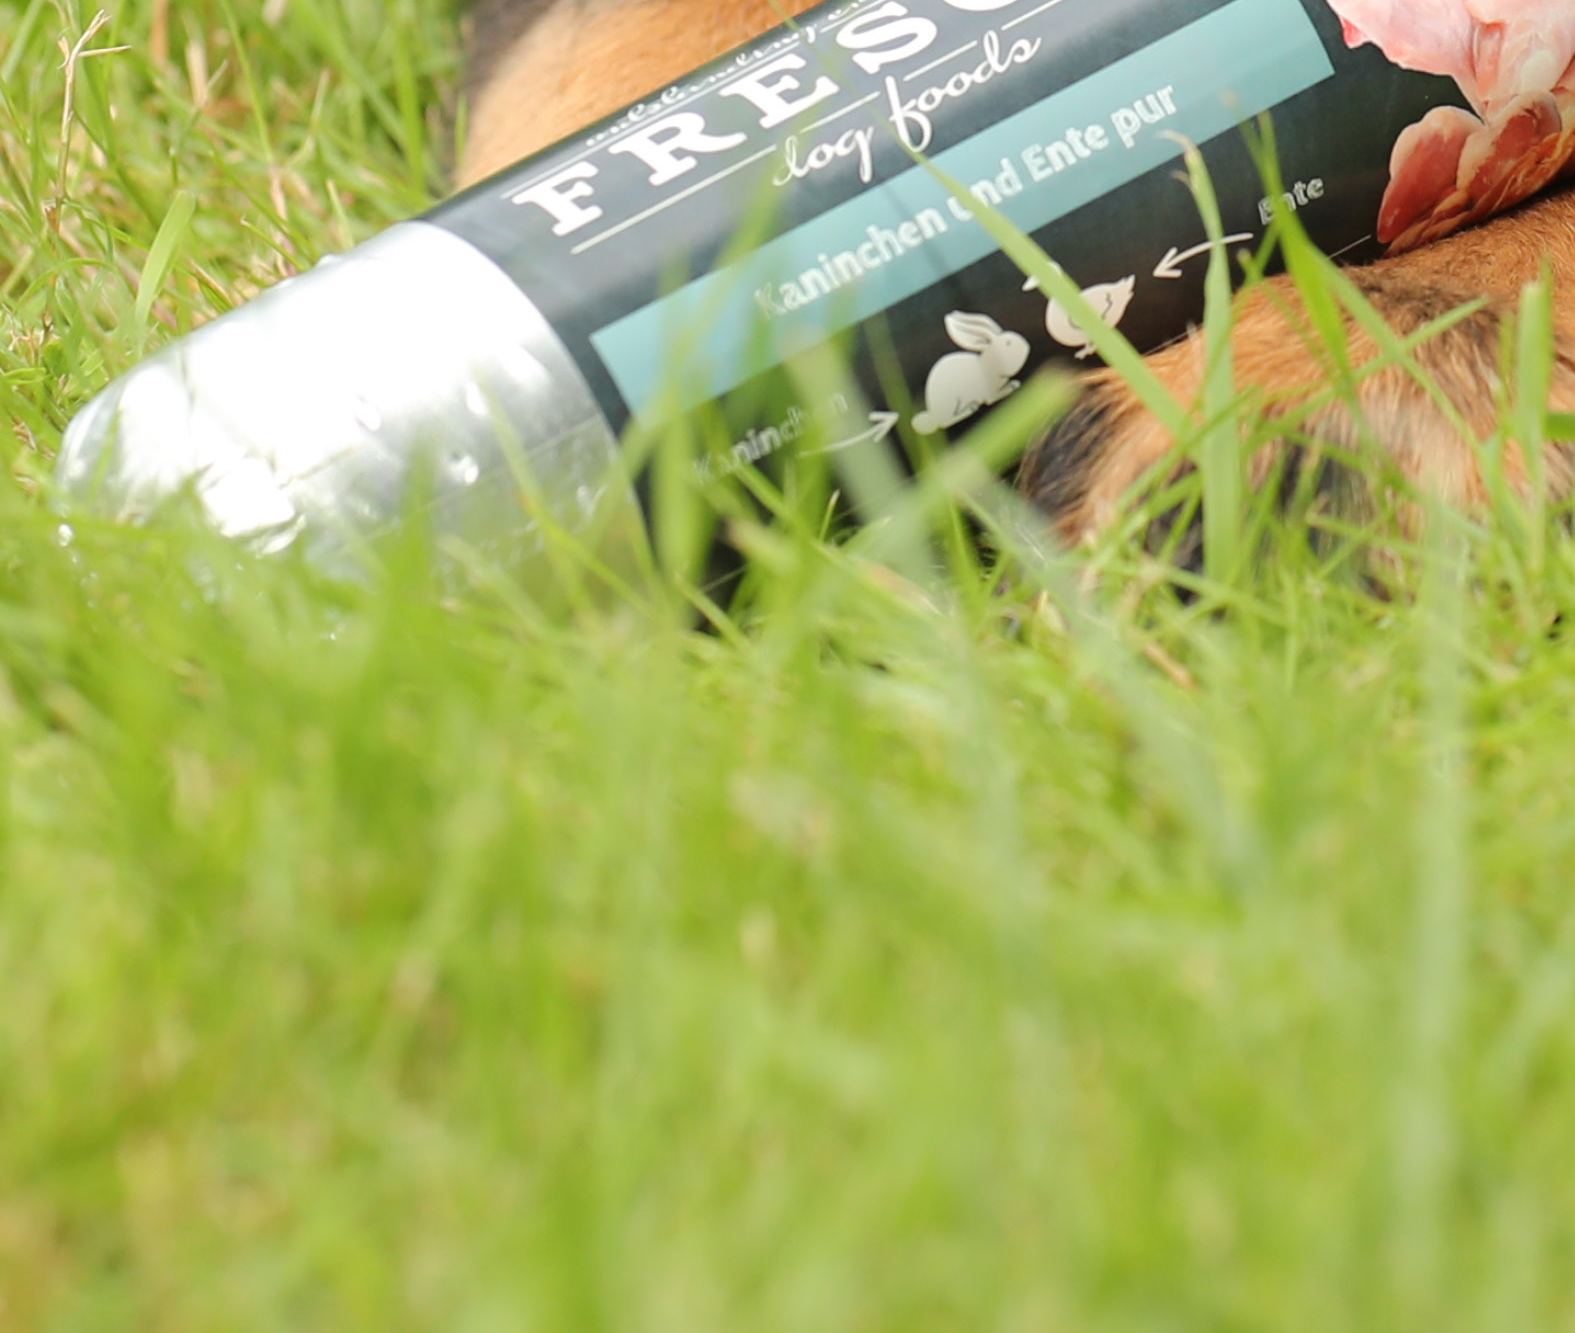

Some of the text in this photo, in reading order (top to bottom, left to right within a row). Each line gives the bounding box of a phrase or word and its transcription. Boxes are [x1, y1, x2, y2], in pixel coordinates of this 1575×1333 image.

[753, 84, 1177, 319] Kaninchen und Ente pur
[772, 30, 1042, 186] dog foods
